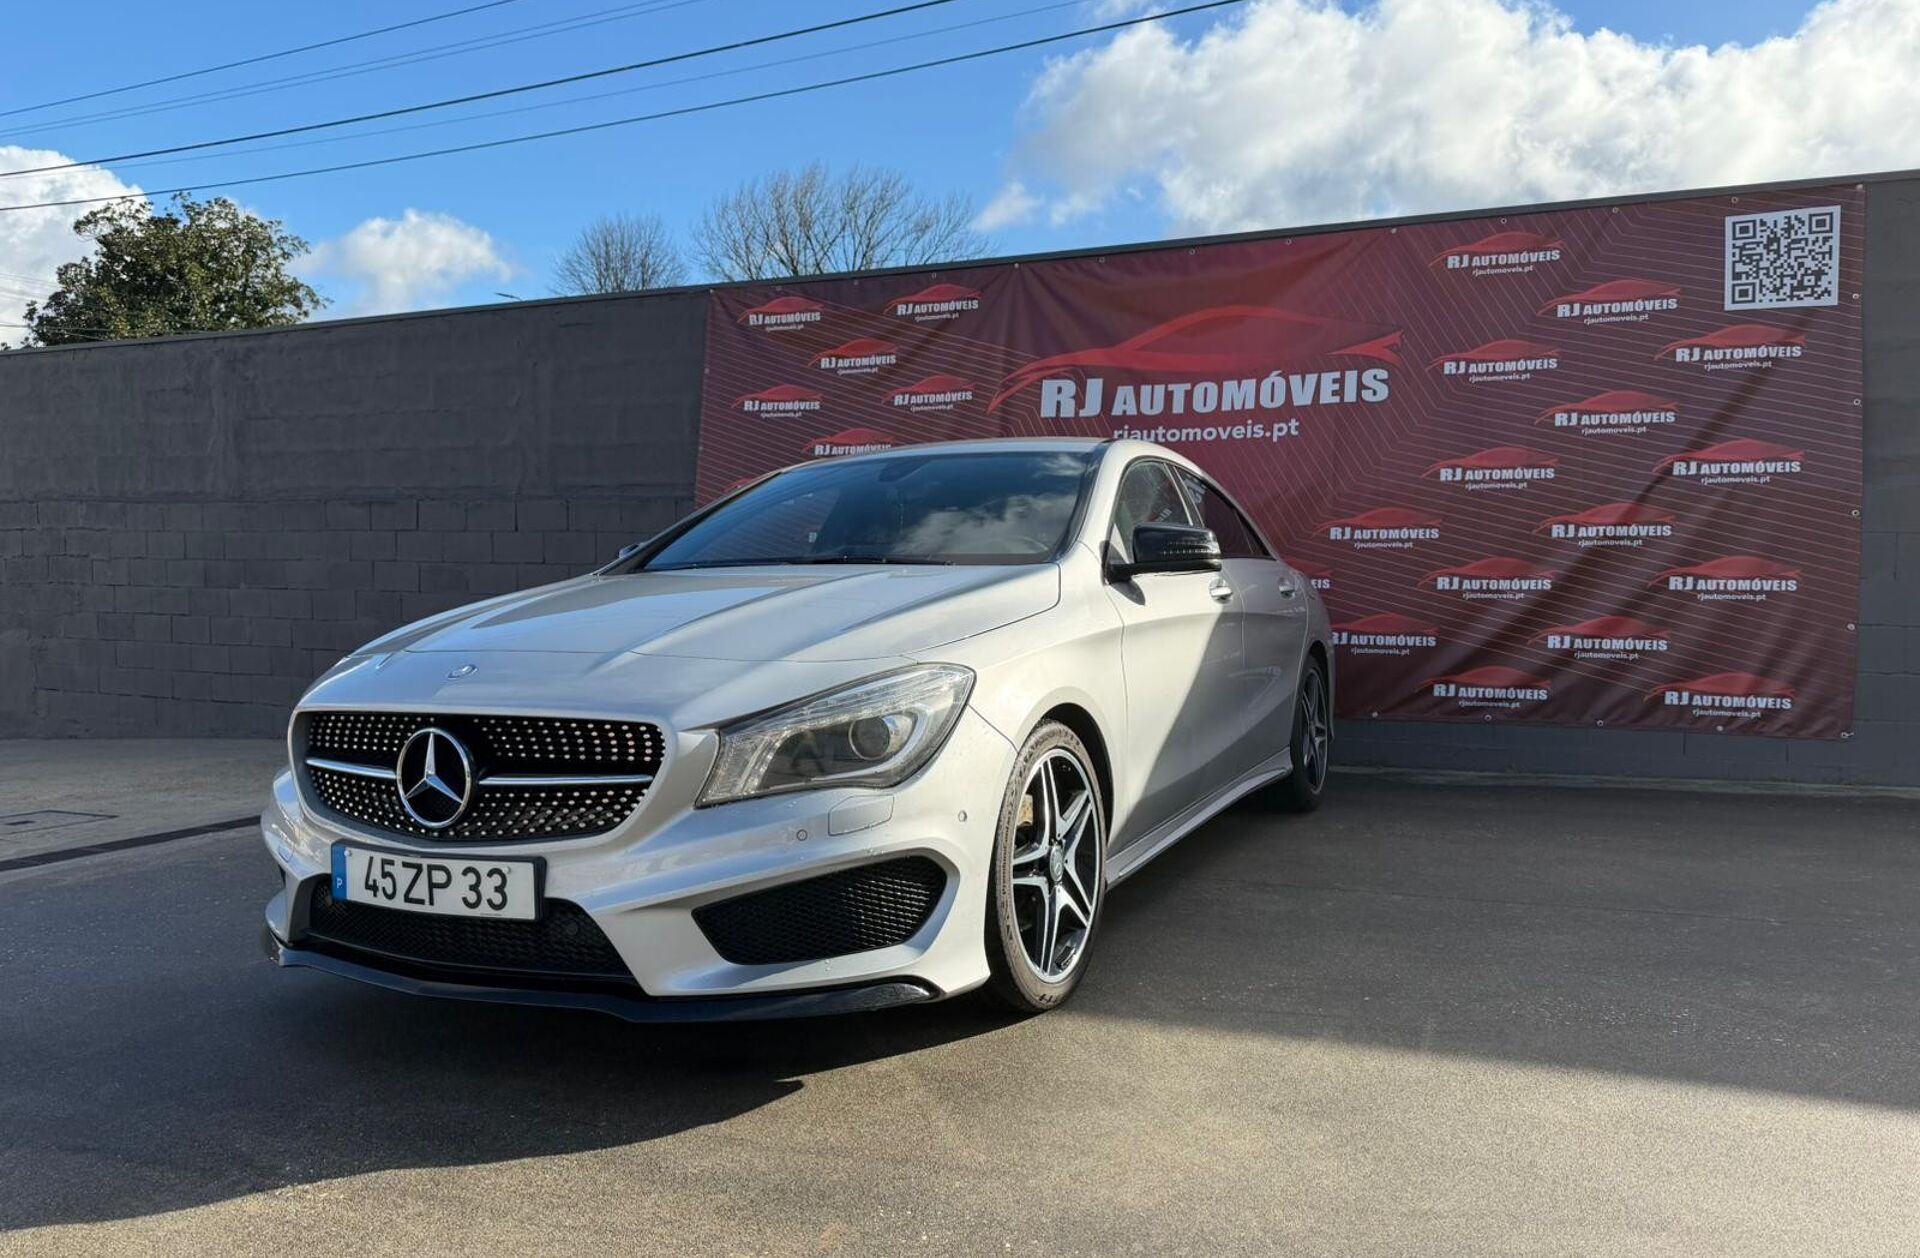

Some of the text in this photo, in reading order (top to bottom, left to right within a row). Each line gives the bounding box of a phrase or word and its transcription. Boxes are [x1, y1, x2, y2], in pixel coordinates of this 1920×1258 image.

[1447, 249, 1560, 269] RJ AUTOMÓVEIS
[897, 300, 979, 315] RJ AUTOMÓVEIS
[1557, 298, 1677, 318] RJ AUTOMÓVEIS
[750, 312, 821, 325] RJ AUTOMÓVEIS
[820, 355, 896, 368] RJ AUTOMÓVEIS
[1675, 345, 1801, 362] RJ AUTOMÓVEIS
[1444, 357, 1557, 374] RJ AUTOMÓVEIS
[894, 391, 973, 406] RJ AUTOMÓVEIS
[1040, 368, 1390, 418] RJ AUTOMÓVEIS
[744, 400, 820, 411] RJ AUTOMÓVEIS
[1555, 410, 1675, 426] RJ AUTOMÓVEIS
[1113, 417, 1299, 442] rjautomoveis.pt
[815, 445, 829, 455] RJ
[1440, 467, 1555, 481] RJ AUTOMÓVEIS
[1672, 459, 1800, 476] RJ AUTOMÓVEIS
[1330, 527, 1439, 540] RJ AUTOMÓVEIS
[1551, 523, 1672, 538] RJ AUTOMÓVEIS
[1437, 576, 1552, 590] RJ AUTOMÓVEIS
[1669, 576, 1797, 592] RJ AUTOMÓVEIS
[1350, 634, 1437, 647] AUTOMÓVEIS
[1547, 635, 1667, 651] RJ AUTOMÓVEIS
[1433, 684, 1548, 700] RJ AUTOMÓVEIS
[1665, 691, 1791, 710] RJ AUTOMÓVEIS
